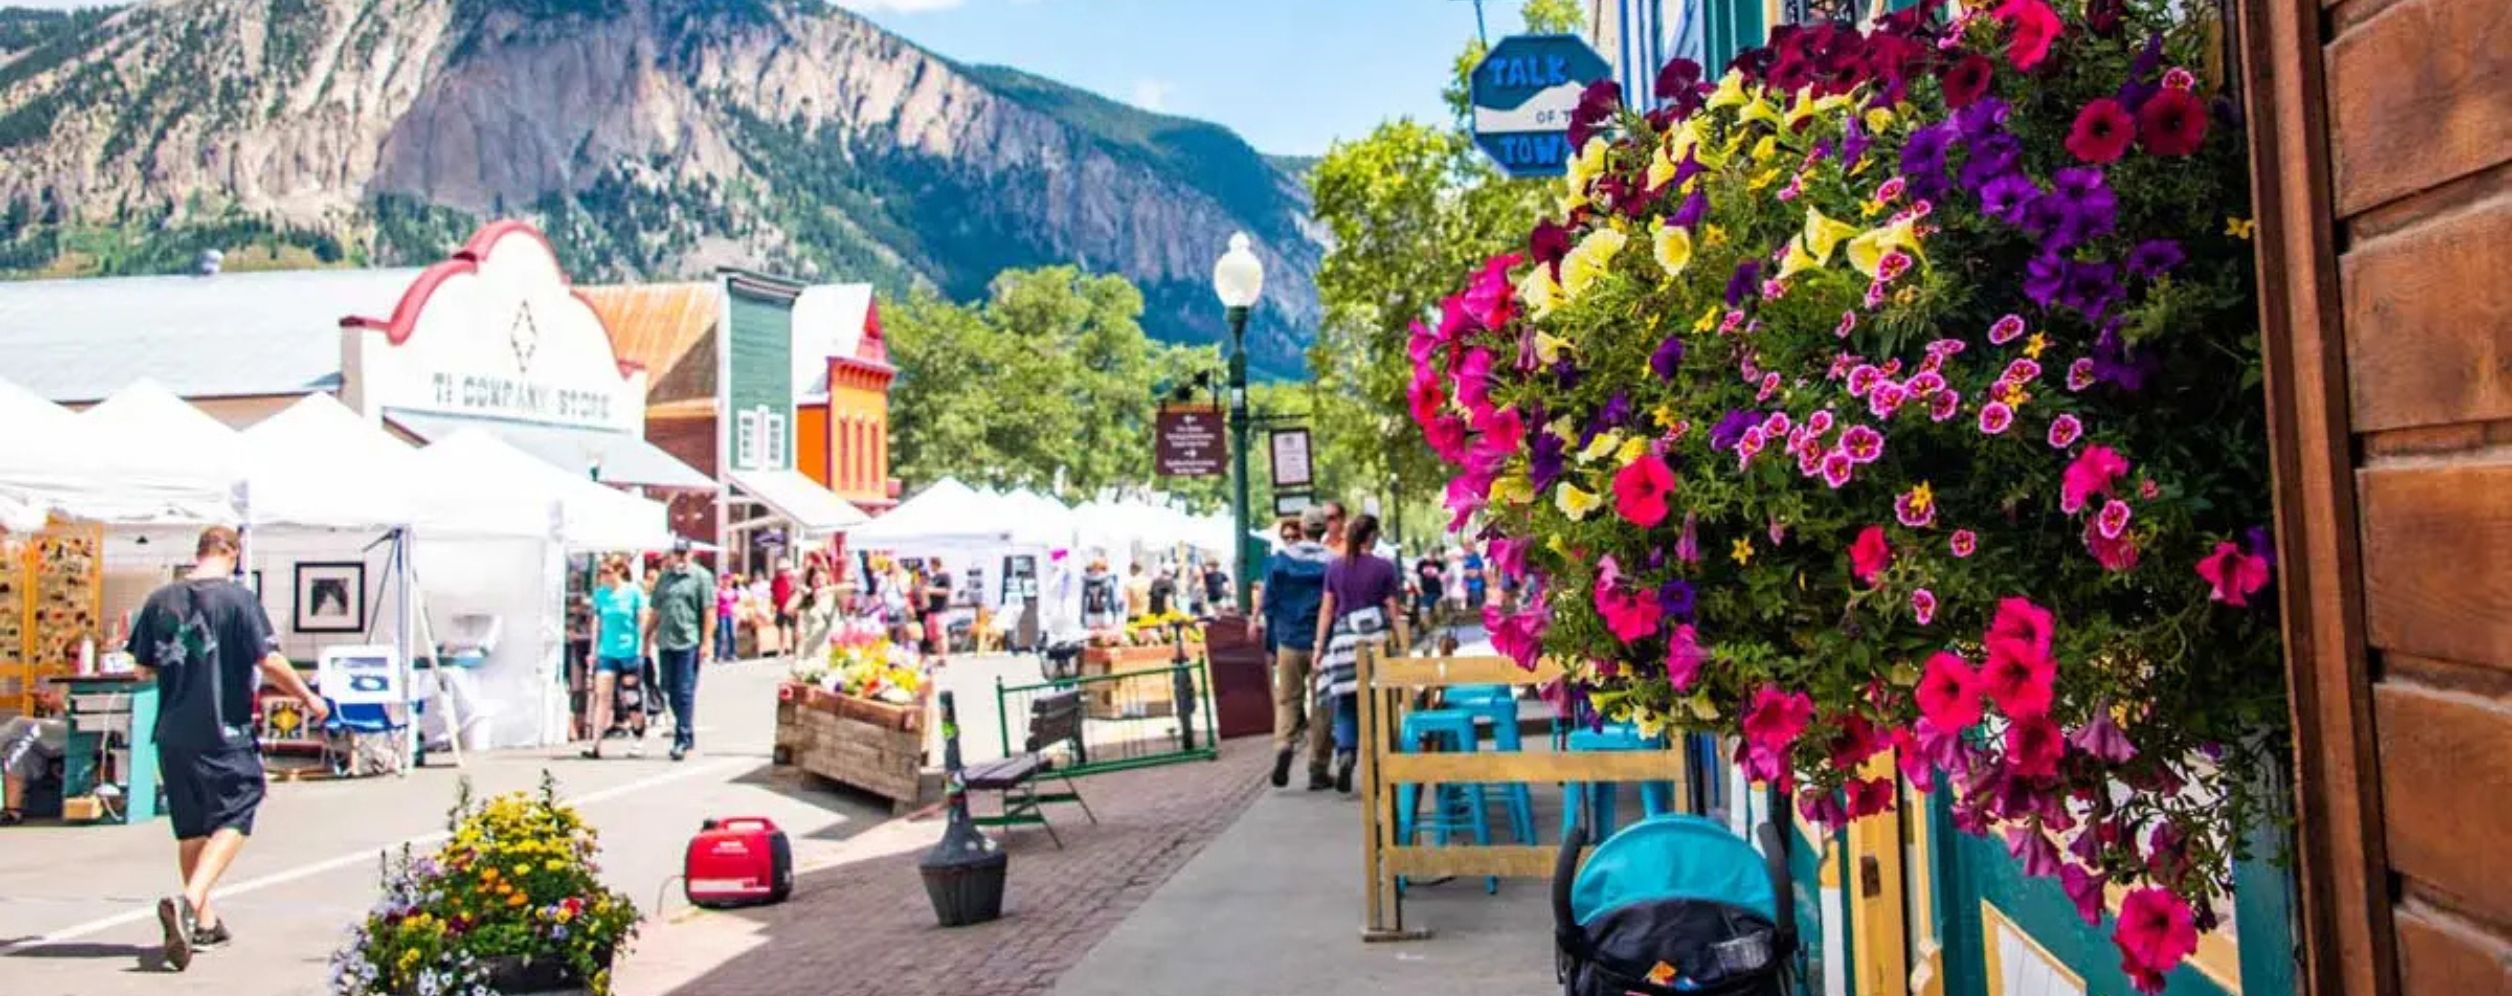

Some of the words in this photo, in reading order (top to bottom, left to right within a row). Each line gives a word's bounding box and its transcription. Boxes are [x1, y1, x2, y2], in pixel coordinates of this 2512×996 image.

[1487, 54, 1566, 86] TALK
[1536, 110, 1555, 124] OF
[1500, 134, 1571, 164] TOW
